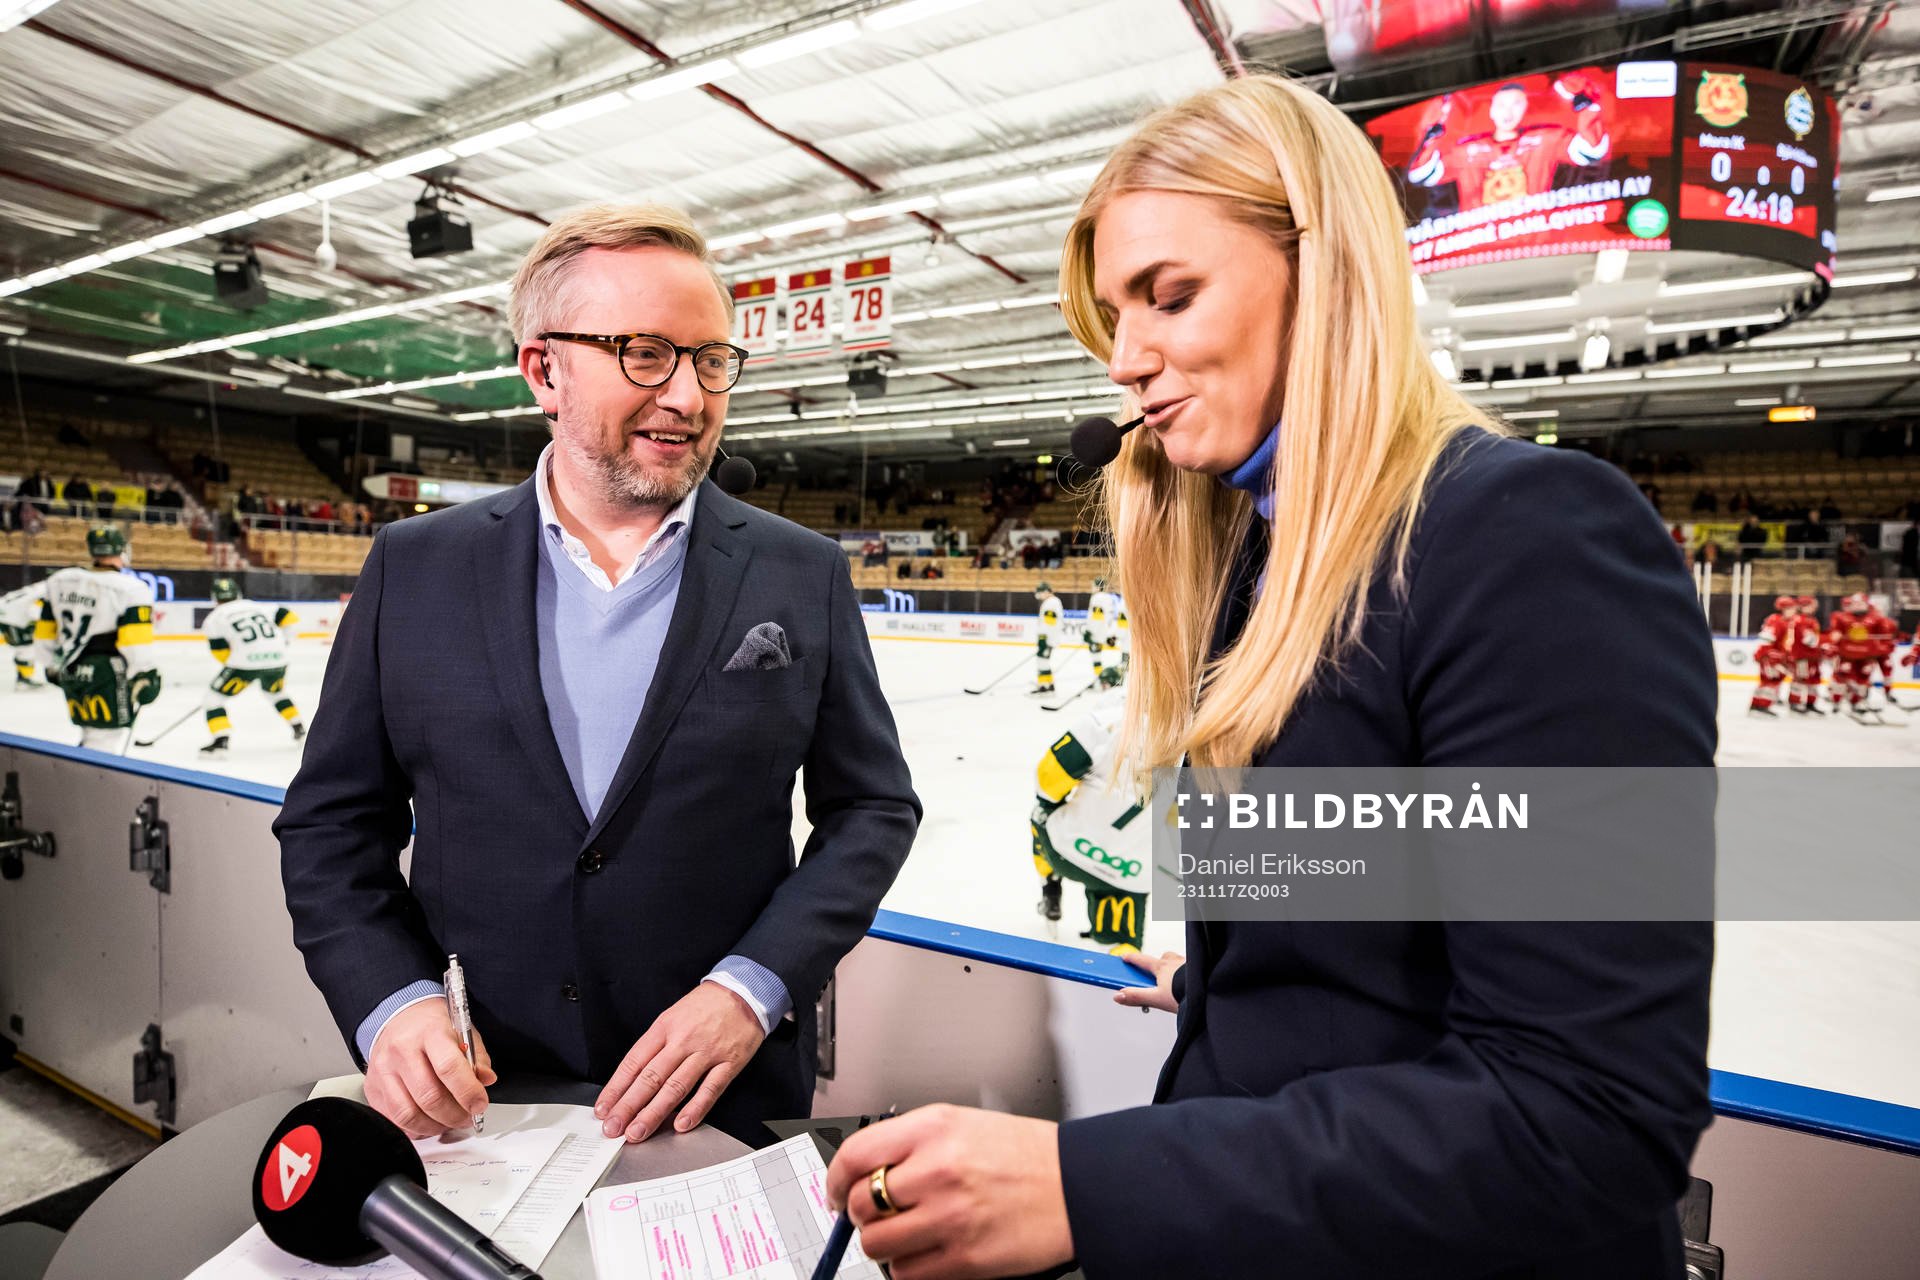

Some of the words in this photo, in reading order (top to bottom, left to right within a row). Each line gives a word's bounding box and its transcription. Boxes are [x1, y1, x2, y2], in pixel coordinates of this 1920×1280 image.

[1711, 152, 1732, 182] 0
[1622, 175, 1652, 198] AV
[1498, 204, 1607, 240] DAHLQVIST
[1725, 186, 1794, 224] 24:18
[794, 297, 825, 332] 24
[851, 286, 883, 322] 78
[743, 306, 767, 339] 17
[1074, 838, 1142, 878] coop
[278, 1142, 312, 1203] 4
